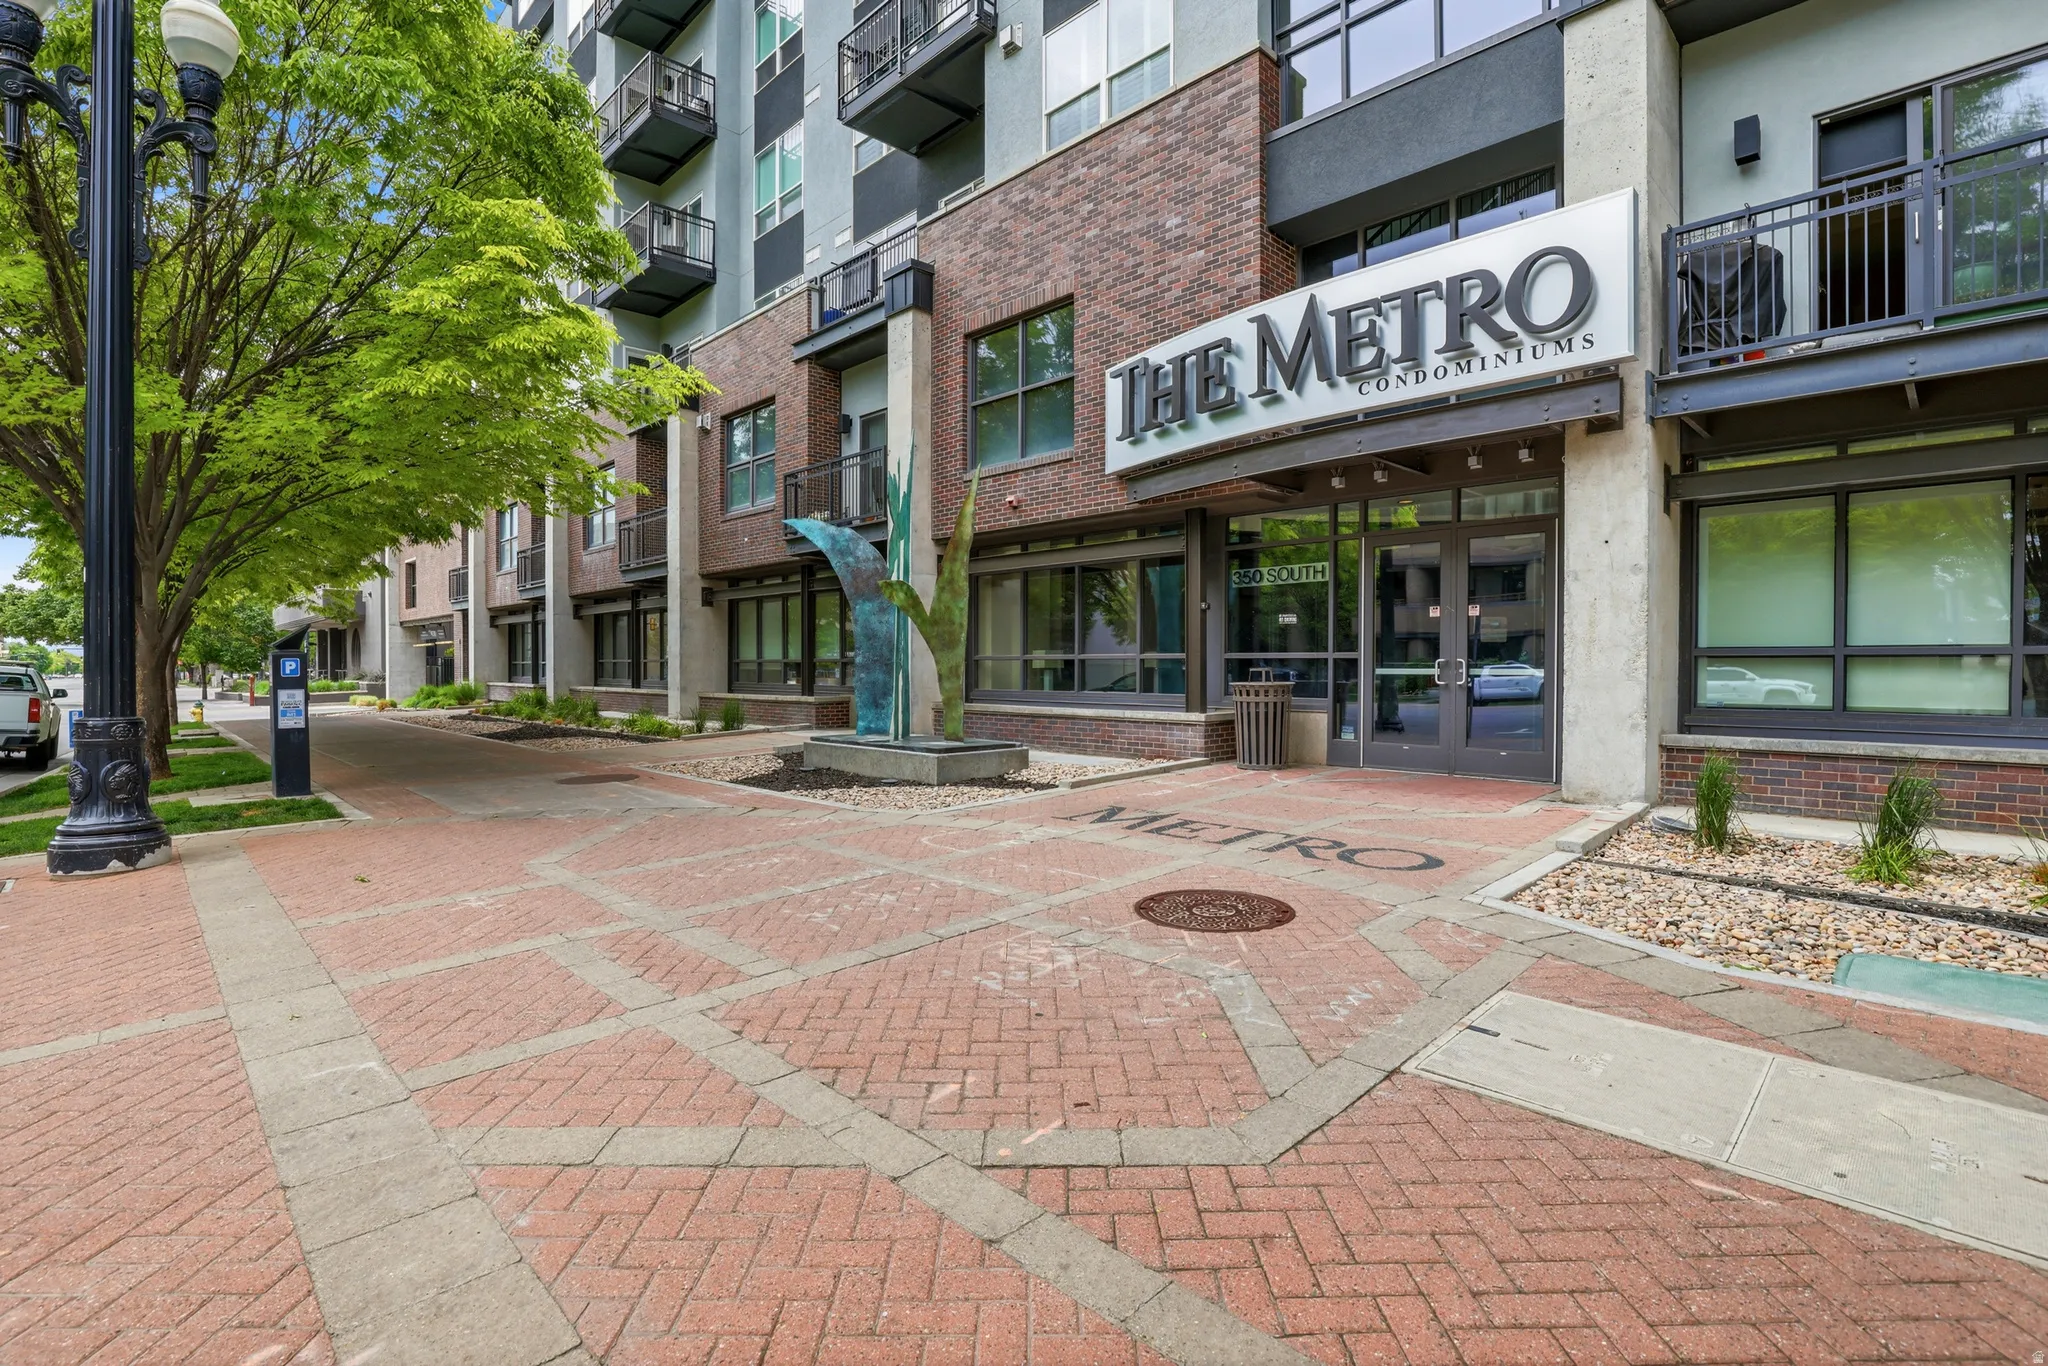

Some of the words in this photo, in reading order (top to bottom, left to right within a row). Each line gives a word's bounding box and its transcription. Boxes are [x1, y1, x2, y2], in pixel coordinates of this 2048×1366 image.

[1109, 336, 1237, 441] THE
[1247, 245, 1592, 400] METRO
[1357, 332, 1595, 396] CONDOMINIUMS
[1232, 569, 1262, 585] 350
[1266, 564, 1325, 583] SOUTH
[285, 661, 296, 674] P
[1051, 804, 1446, 872] METRO
